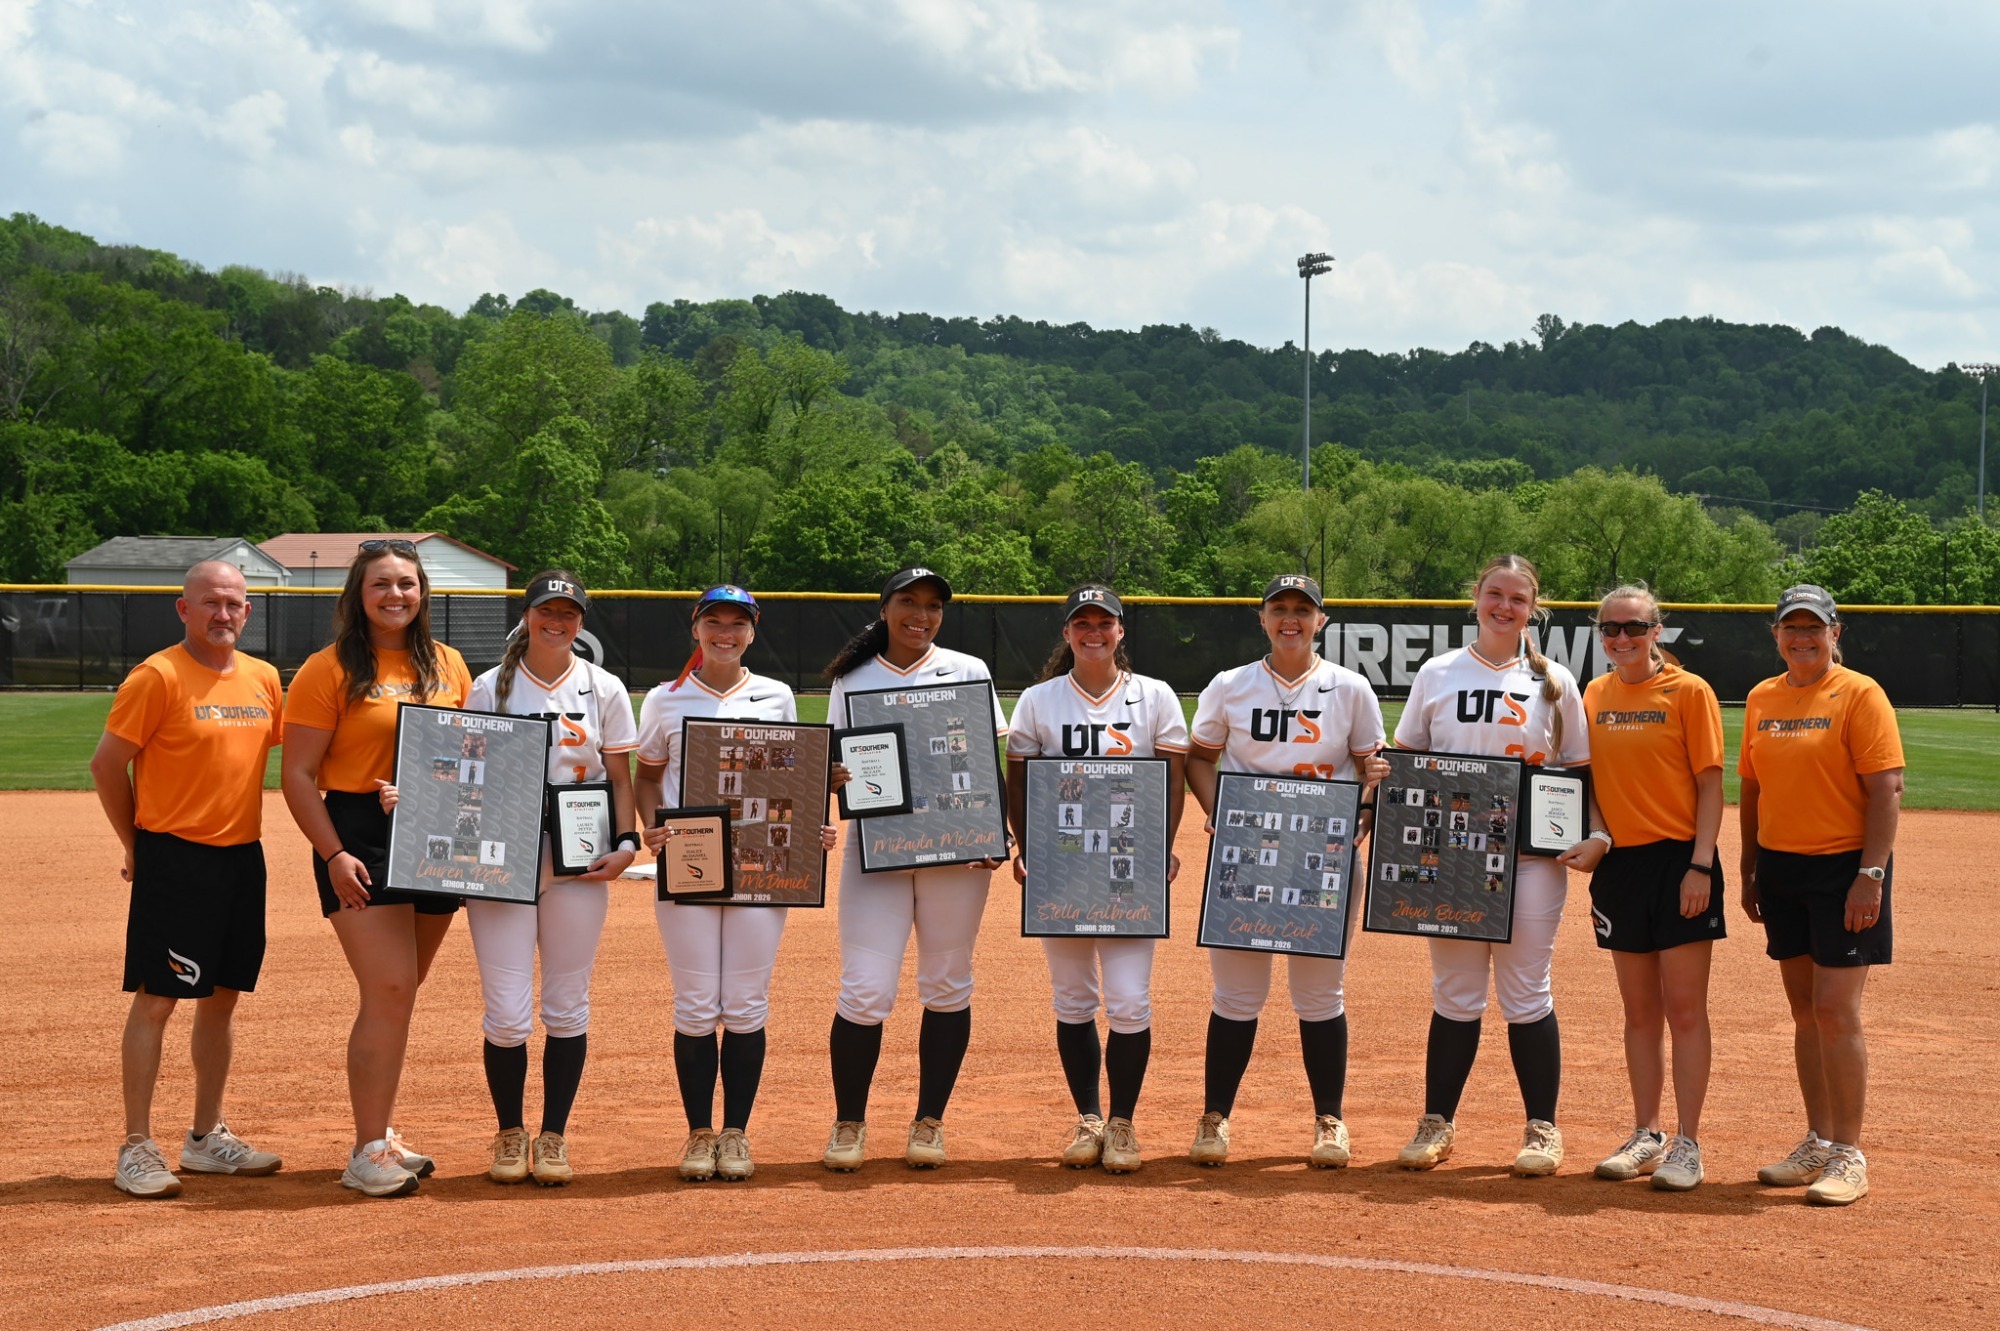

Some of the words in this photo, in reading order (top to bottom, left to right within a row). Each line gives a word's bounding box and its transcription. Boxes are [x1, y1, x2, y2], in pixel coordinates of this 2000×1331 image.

[548, 580, 574, 595] UTS
[1079, 590, 1104, 602] UTS
[1457, 689, 1530, 727] UTS
[1251, 708, 1322, 744] UTS
[1062, 722, 1132, 757] UTS
[415, 858, 465, 880] Lauren
[441, 880, 465, 890] SENIOR
[466, 882, 485, 891] 2026
[753, 893, 772, 902] 2026
[1036, 902, 1081, 921] Stella
[1098, 924, 1116, 933] 2026
[1417, 923, 1440, 932] SENIOR
[1440, 925, 1458, 934] 2026
[1274, 940, 1292, 949] 2026
